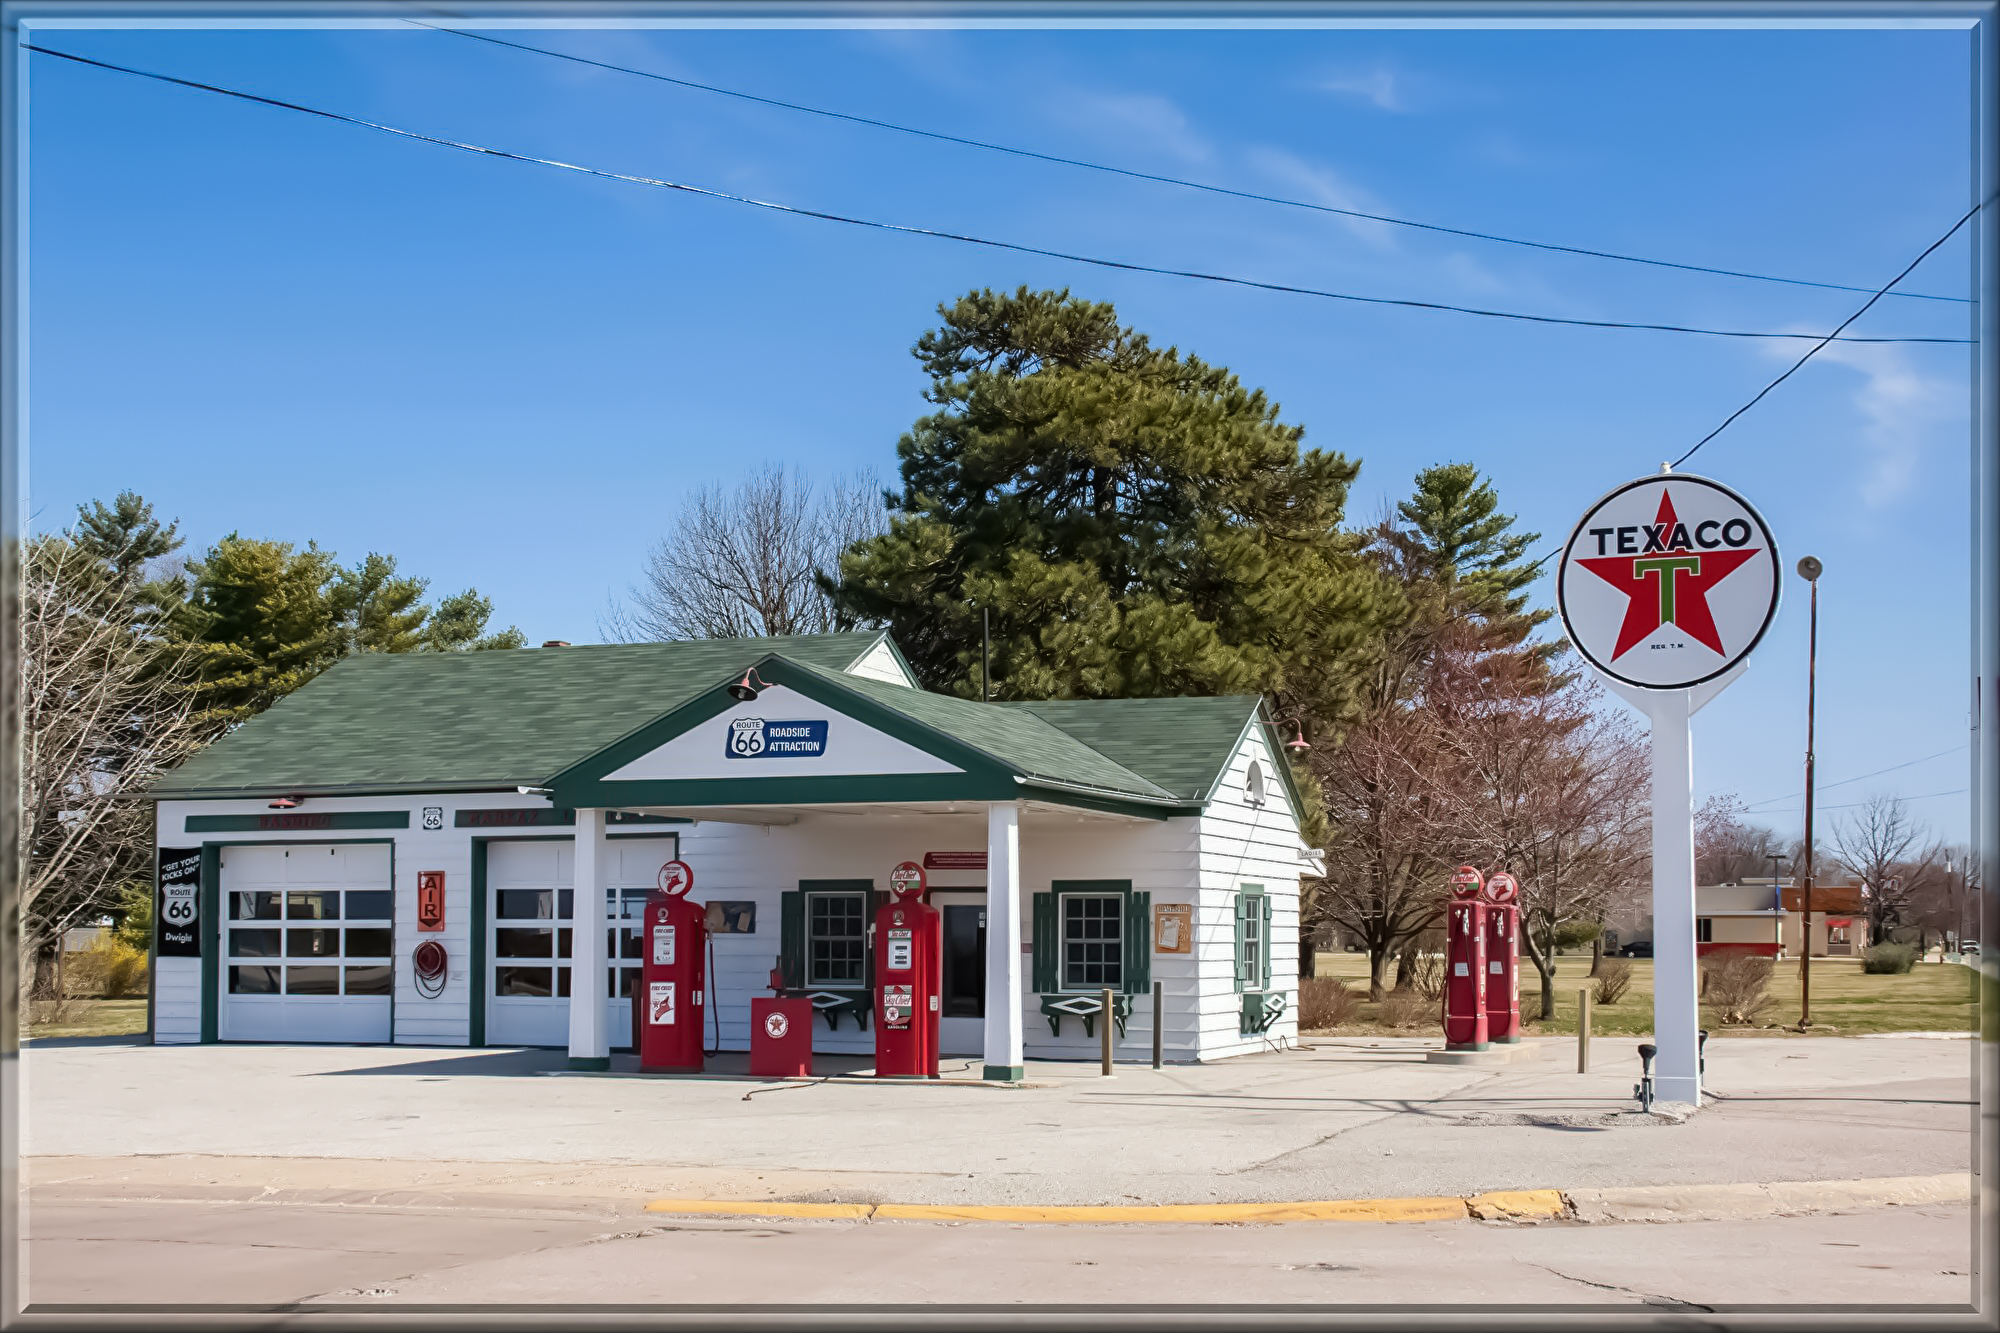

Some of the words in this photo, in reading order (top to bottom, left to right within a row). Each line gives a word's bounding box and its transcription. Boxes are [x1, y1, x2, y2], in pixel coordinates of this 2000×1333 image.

[1589, 518, 1752, 556] TEXACO
[1633, 556, 1701, 627] T
[736, 721, 760, 729] ROUTE
[769, 727, 811, 738] ROADSIDE
[736, 731, 761, 753] 66
[769, 741, 820, 751] ATTRACTION
[426, 815, 439, 826] 66
[162, 869, 183, 881] KICKS
[170, 888, 191, 896] ROUTE
[424, 876, 437, 918] AIR
[169, 901, 192, 919] 66
[165, 932, 193, 944] Dwight
